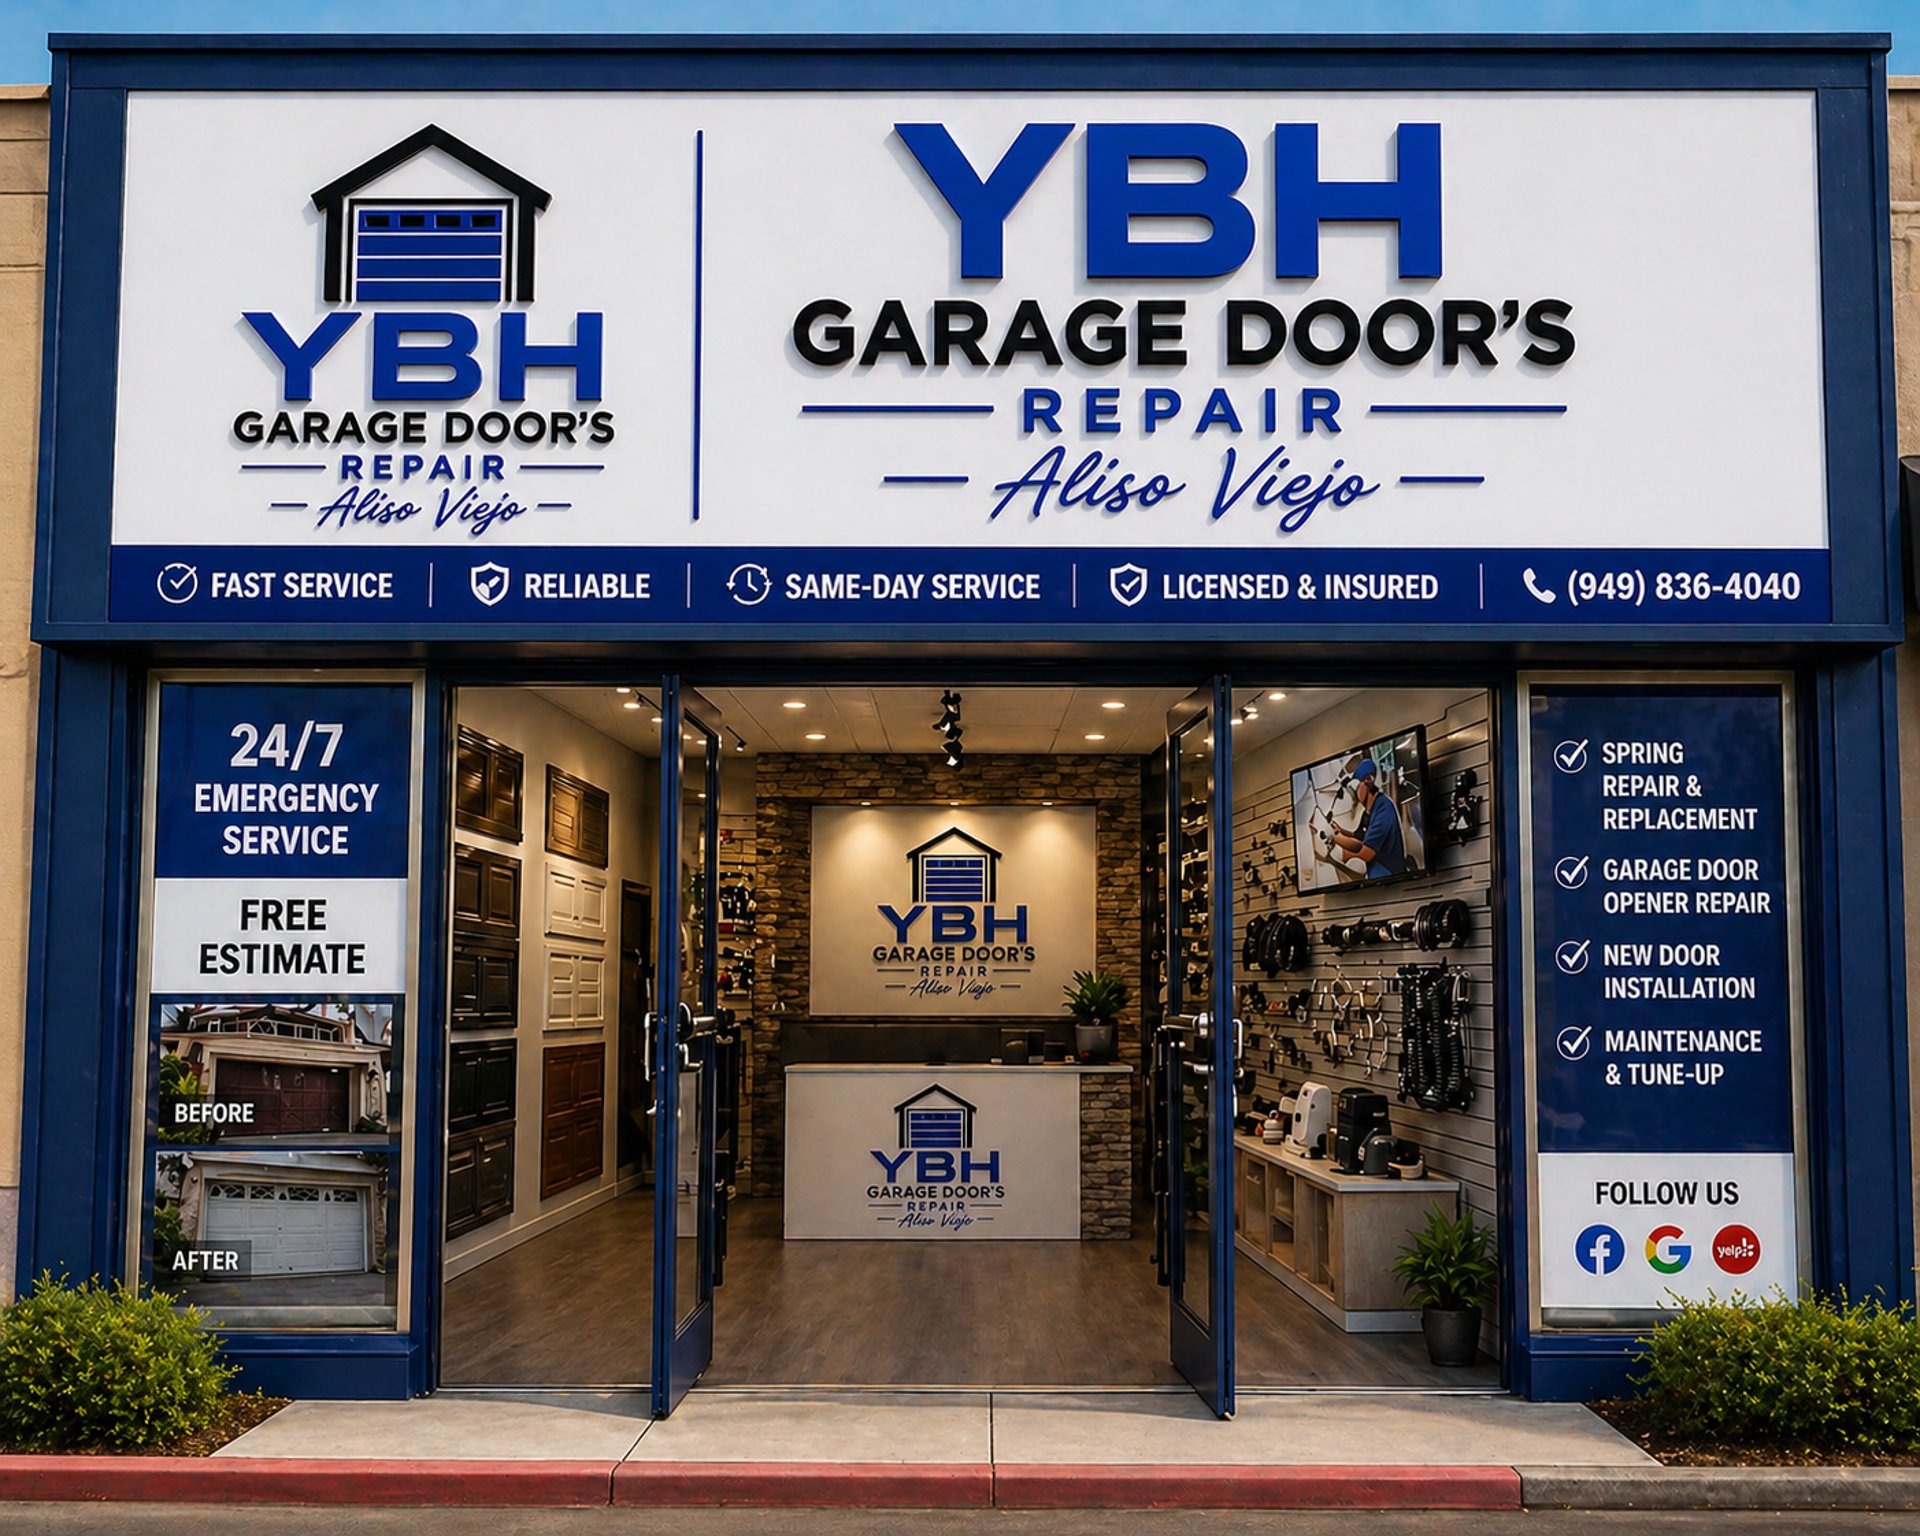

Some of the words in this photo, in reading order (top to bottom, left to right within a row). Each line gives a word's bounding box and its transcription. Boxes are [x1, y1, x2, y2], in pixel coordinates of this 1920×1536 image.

[892, 123, 1443, 279] YBH
[793, 299, 1187, 367] GARAGE
[1226, 299, 1576, 366] DOOR'S
[240, 311, 603, 401] YBH
[1023, 388, 1341, 434] REPAIR
[233, 411, 427, 443] GARAGE
[445, 411, 615, 443] DOOR'S
[341, 455, 505, 480] REPAIR
[990, 446, 1186, 522] Aliso
[1210, 446, 1380, 533] Viejo
[317, 485, 421, 528] Aliso
[435, 486, 527, 536] Viejo
[211, 573, 275, 598] FAST
[283, 573, 393, 598] SERVICE
[524, 573, 650, 598] RELIABLE
[785, 574, 924, 600] SAME-DAY
[931, 574, 1040, 600] SERVICE
[1163, 574, 1289, 600] LICENSED
[1297, 575, 1317, 600] &
[1324, 574, 1439, 600] INSURED
[1567, 570, 1646, 606] (949)
[1655, 572, 1801, 600] 836-4040
[230, 720, 343, 771] 24/7
[1602, 742, 1684, 764] SPRING
[195, 783, 379, 812] EMERGENCY
[1603, 775, 1679, 797] REPAIR
[1686, 775, 1702, 797] &
[1603, 808, 1757, 830] REPLACEMENT
[222, 826, 348, 855] SERVICE
[1603, 858, 1691, 881] GARAGE
[1698, 858, 1759, 881] DOOR
[240, 899, 327, 931] FREE
[1603, 891, 1689, 914] OPENER
[1696, 891, 1771, 914] REPAIR
[877, 905, 1027, 943] YBH
[200, 943, 365, 974] ESTIMATE
[873, 947, 955, 961] GARAGE
[962, 947, 1035, 961] DOOR'S
[1604, 944, 1652, 966] NEW
[1659, 944, 1720, 966] DOOR
[920, 966, 987, 977] REPAIR
[1605, 977, 1756, 999] INSTALLATION
[1605, 1030, 1762, 1052] MAINTENANCE
[1605, 1063, 1621, 1086] &
[1627, 1063, 1724, 1086] TUNE-UP
[175, 1103, 254, 1123] BEFORE
[870, 1151, 999, 1183] YBH
[867, 1186, 937, 1199] GARAGE
[943, 1186, 1005, 1199] DOOR'S
[1596, 1181, 1698, 1205] FOLLOW
[1706, 1181, 1739, 1205] US
[907, 1201, 965, 1212] REPAIR
[172, 1250, 239, 1271] AFTER
[1645, 1225, 1692, 1274] G
[1717, 1244, 1743, 1259] yelp
